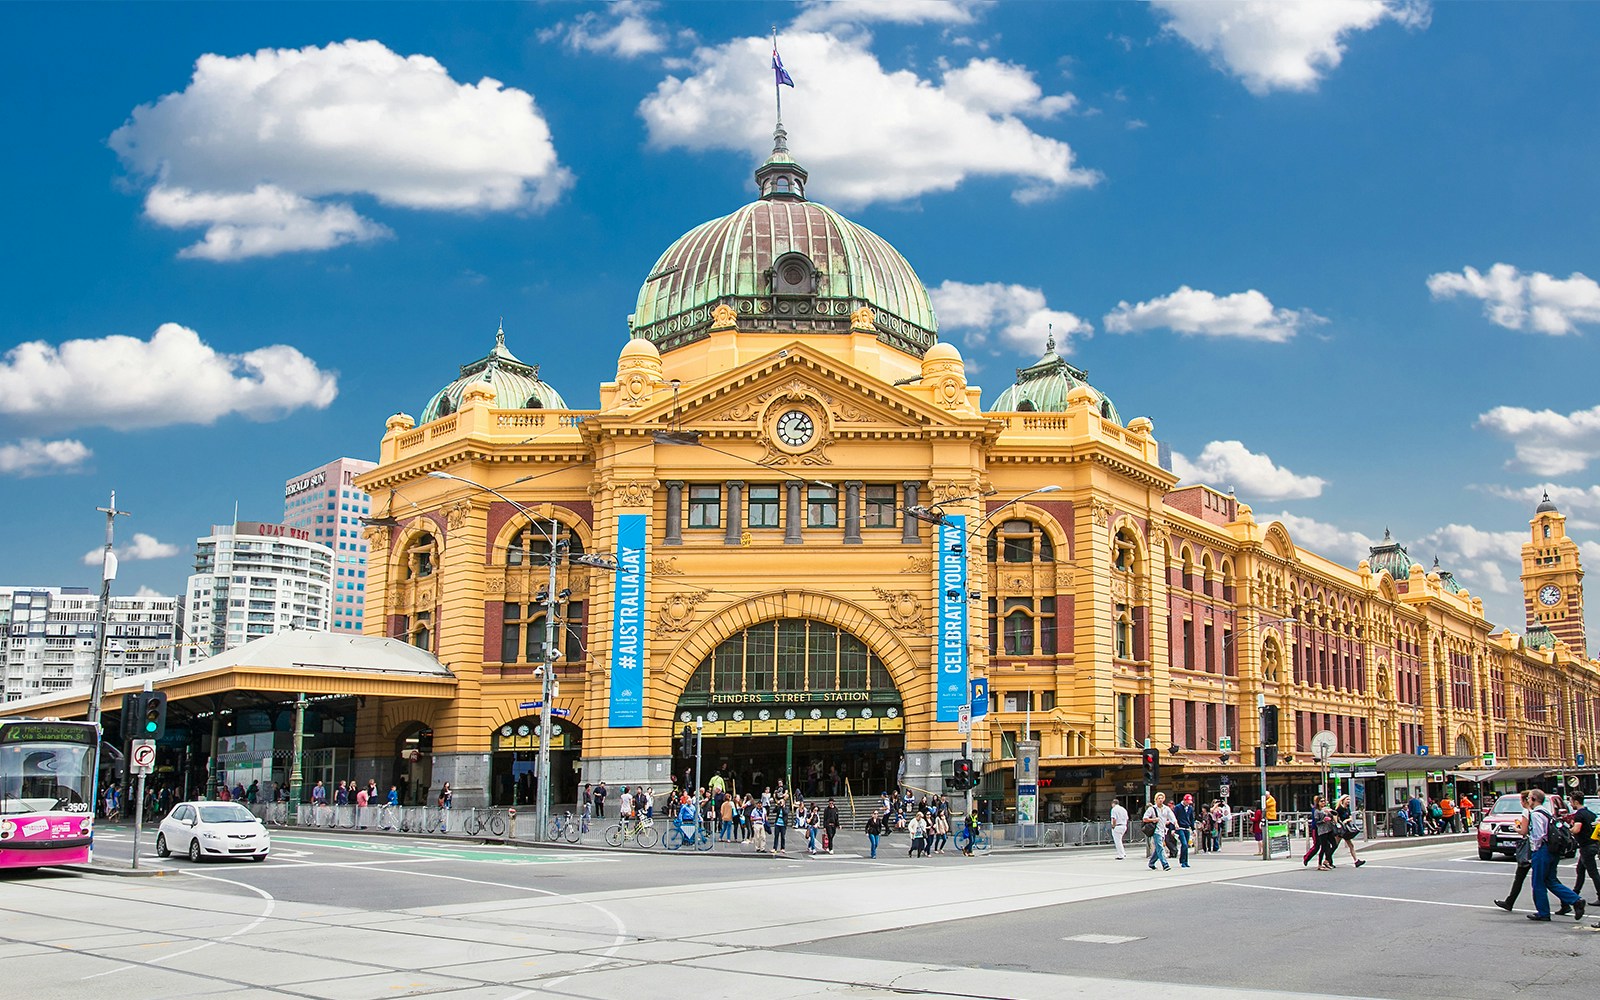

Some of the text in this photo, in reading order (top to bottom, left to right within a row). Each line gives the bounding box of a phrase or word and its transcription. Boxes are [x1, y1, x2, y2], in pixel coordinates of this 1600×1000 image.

[310, 471, 326, 486] SUN
[259, 524, 309, 540] QUAY WEST
[943, 524, 961, 551] WAY
[618, 546, 641, 670] #AUSTRALIADAY
[712, 692, 869, 703] FLINDERS STREET STATION
[68, 802, 88, 812] 3509
